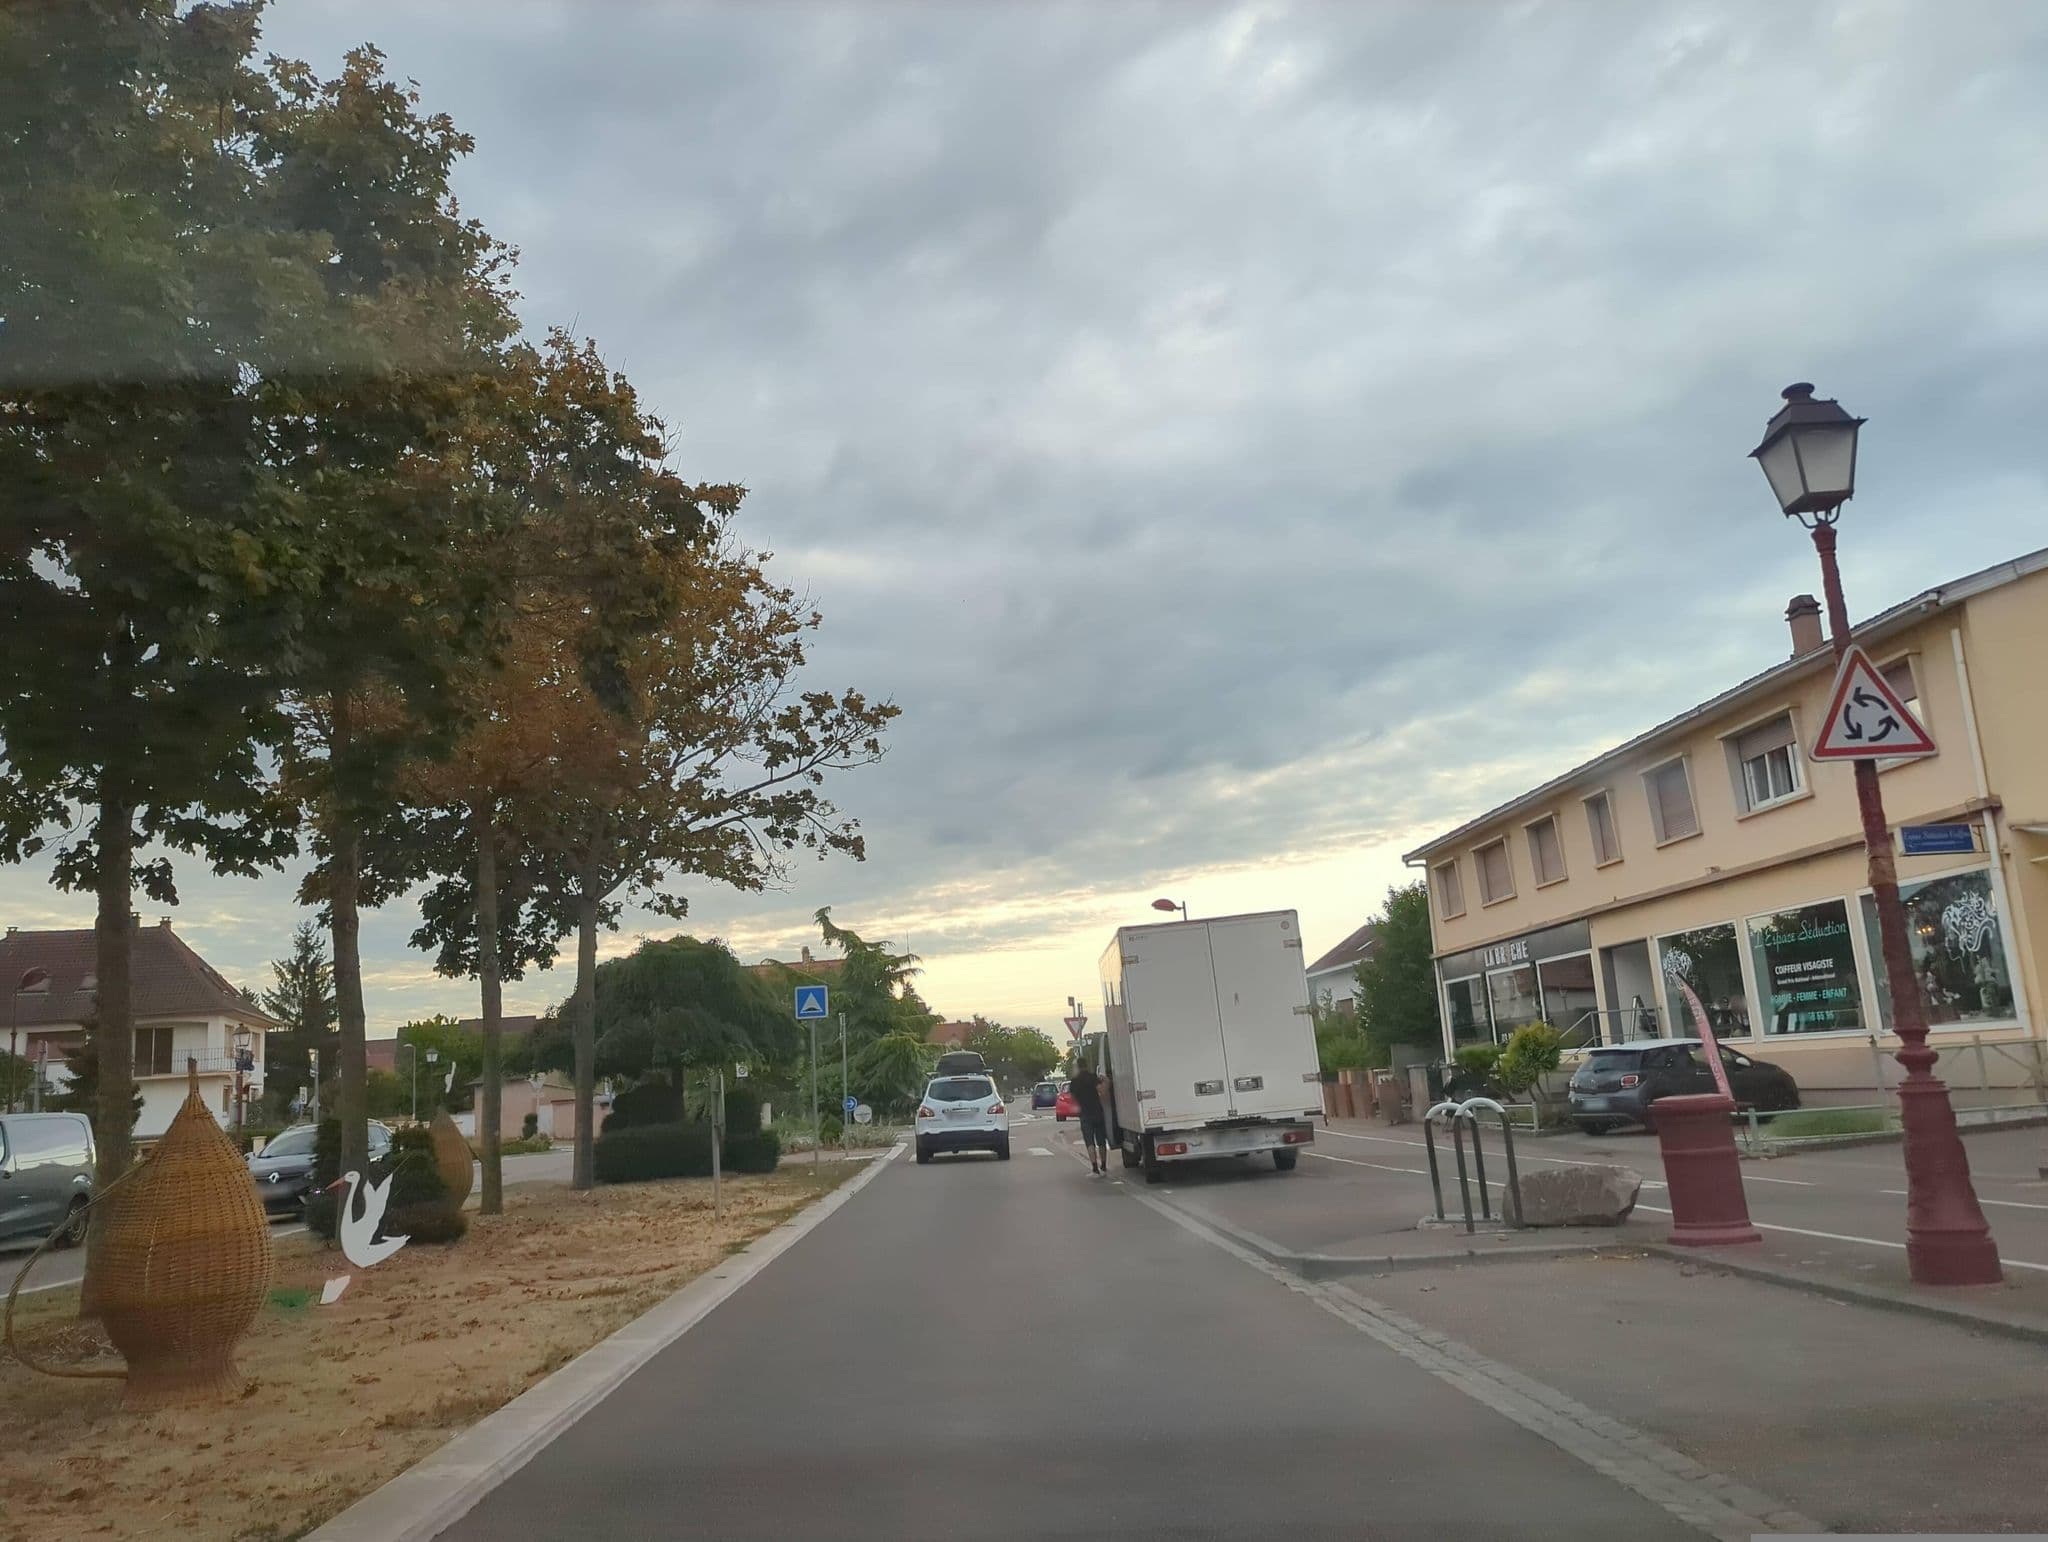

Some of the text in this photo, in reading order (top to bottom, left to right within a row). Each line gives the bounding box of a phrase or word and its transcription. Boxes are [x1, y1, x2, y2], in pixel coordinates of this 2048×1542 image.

[1798, 917, 1847, 941] Séduction
[1495, 941, 1529, 965] BRCHE
[1775, 958, 1834, 976] COIFFEUR VISAGISTE
[1797, 990, 1818, 1001] FEMME
[1822, 987, 1848, 999] ENFANT
